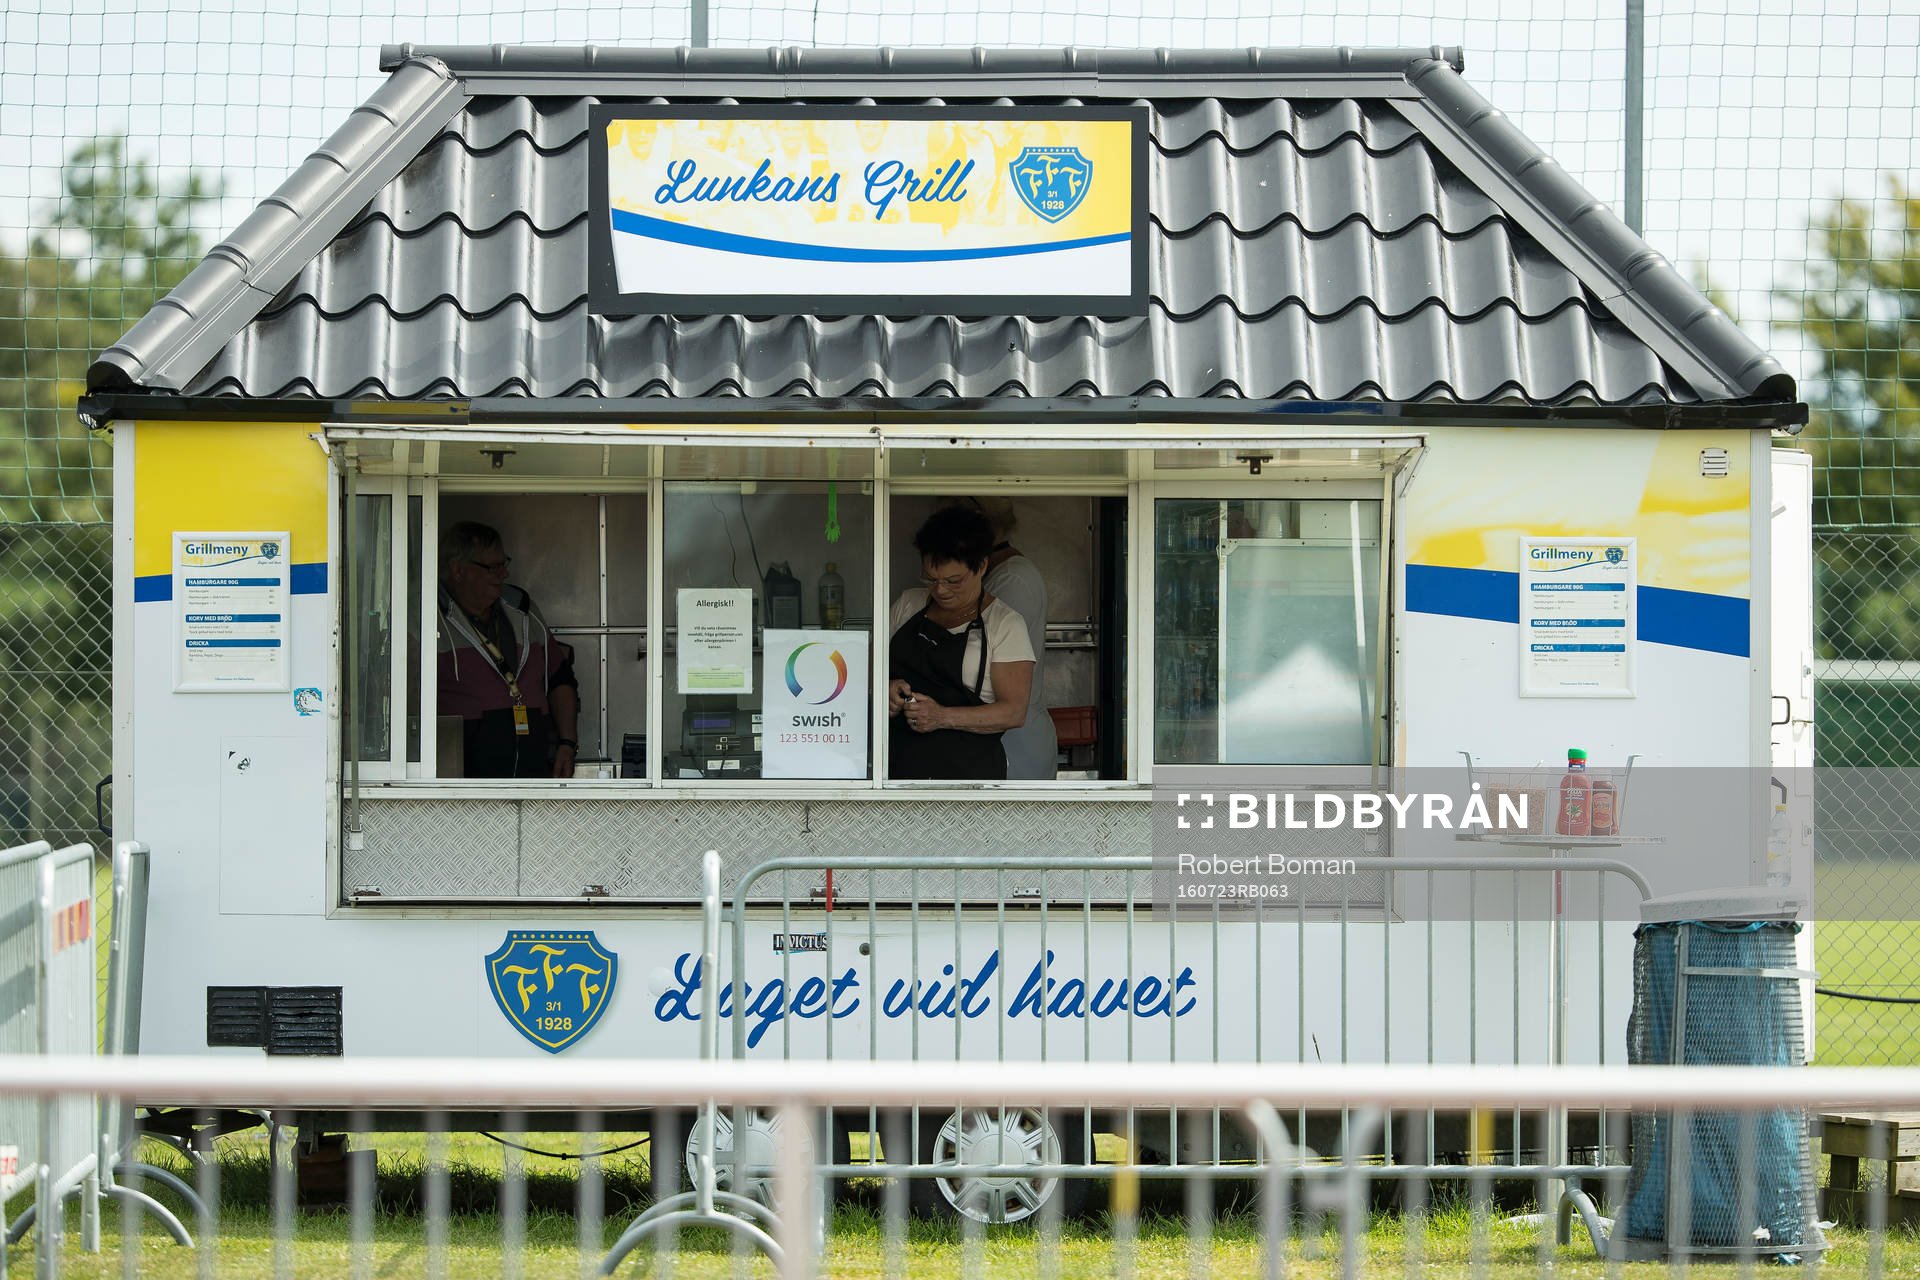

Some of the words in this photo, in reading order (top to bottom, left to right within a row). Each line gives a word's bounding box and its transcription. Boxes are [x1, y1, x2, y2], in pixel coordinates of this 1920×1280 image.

[655, 158, 840, 204] Lunkans
[864, 159, 975, 220] Grill
[1047, 190, 1058, 198] 3/1
[1041, 200, 1065, 210] 1928
[185, 543, 249, 557] Grillmeny
[1530, 548, 1593, 562] Grillmeny
[696, 599, 734, 609] Allergisk!!
[780, 733, 798, 743] 123
[801, 733, 820, 743] 551
[822, 733, 836, 743] 00
[839, 733, 850, 743] 11
[882, 950, 999, 1018] vid
[1007, 950, 1197, 1018] havet
[545, 1001, 562, 1012] 3/1
[536, 1017, 573, 1031] 1928
